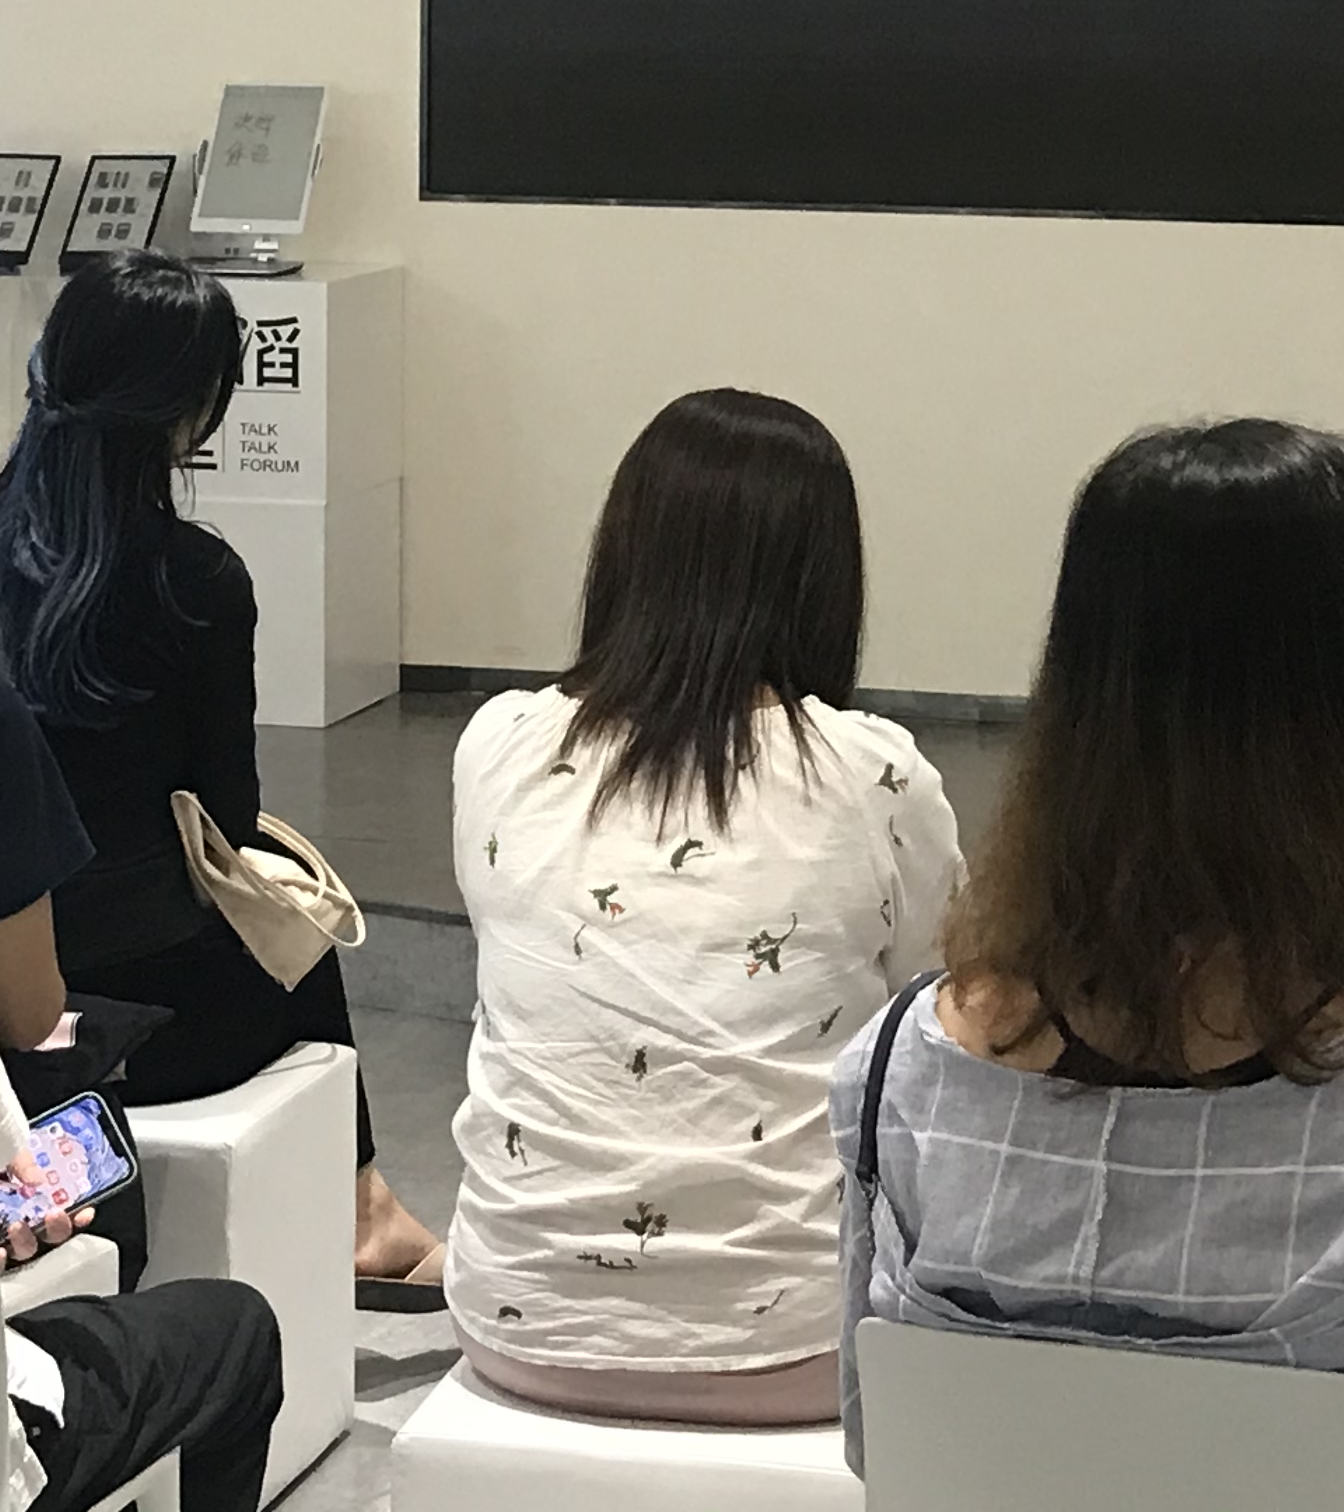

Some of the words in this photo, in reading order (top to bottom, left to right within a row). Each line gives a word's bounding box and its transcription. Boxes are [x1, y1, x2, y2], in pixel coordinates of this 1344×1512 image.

[239, 421, 279, 437] TALK
[239, 439, 279, 455] TALK
[239, 457, 300, 474] FORUM
